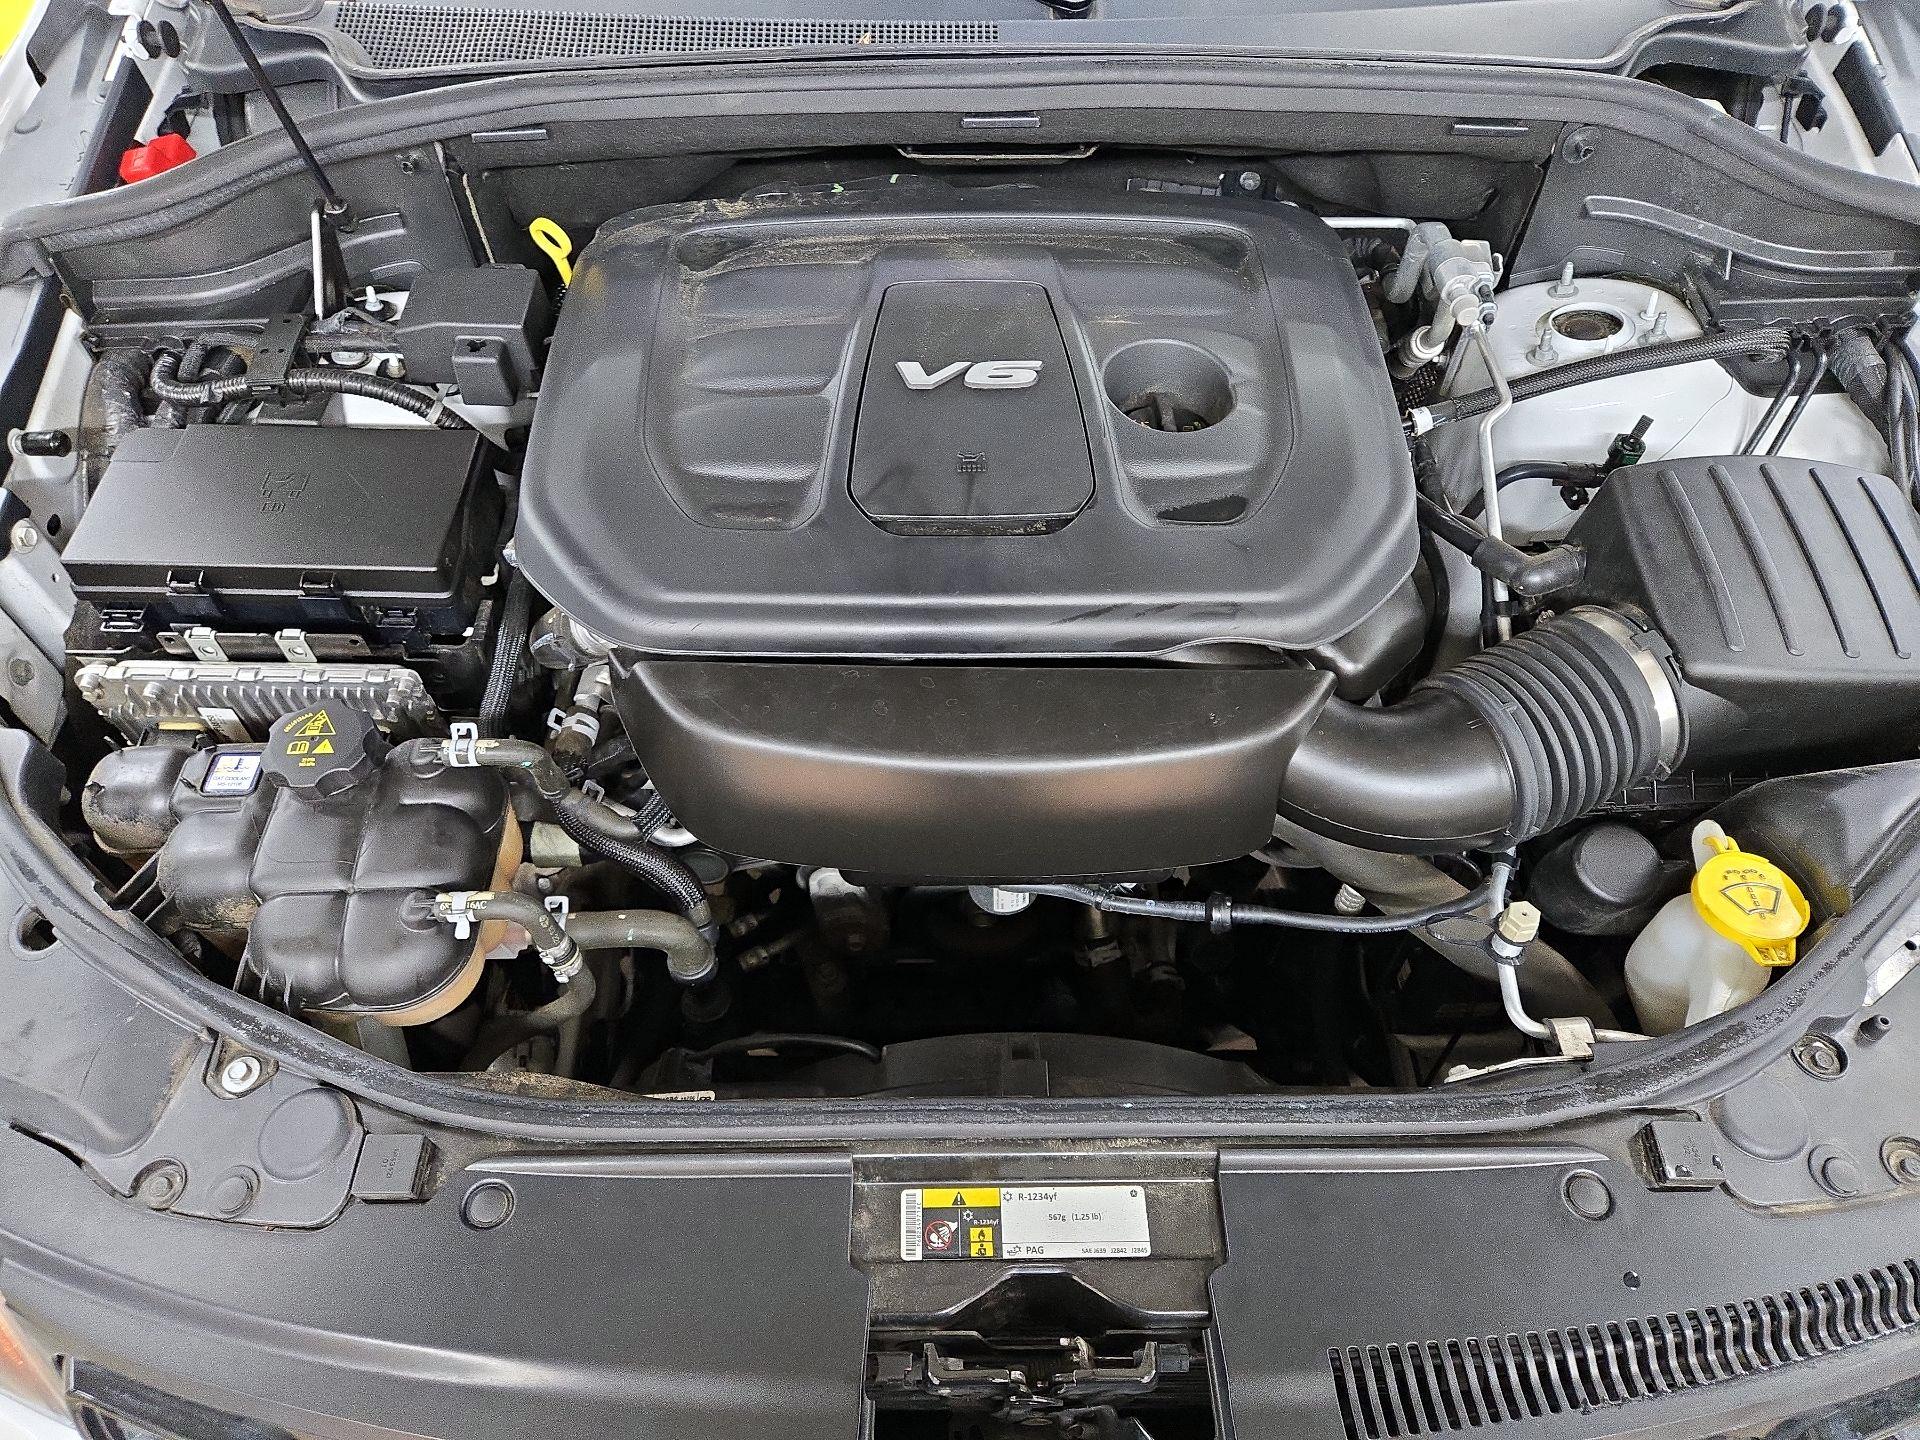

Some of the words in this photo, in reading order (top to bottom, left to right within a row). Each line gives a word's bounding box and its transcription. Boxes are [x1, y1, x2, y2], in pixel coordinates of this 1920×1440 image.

[895, 360, 1044, 389] V6
[1018, 1192, 1058, 1202] R-1234yf
[1048, 1213, 1067, 1222] 567g
[1071, 1212, 1090, 1221] (1.25
[1091, 1212, 1102, 1221] lb)
[1026, 1246, 1044, 1255] PAG
